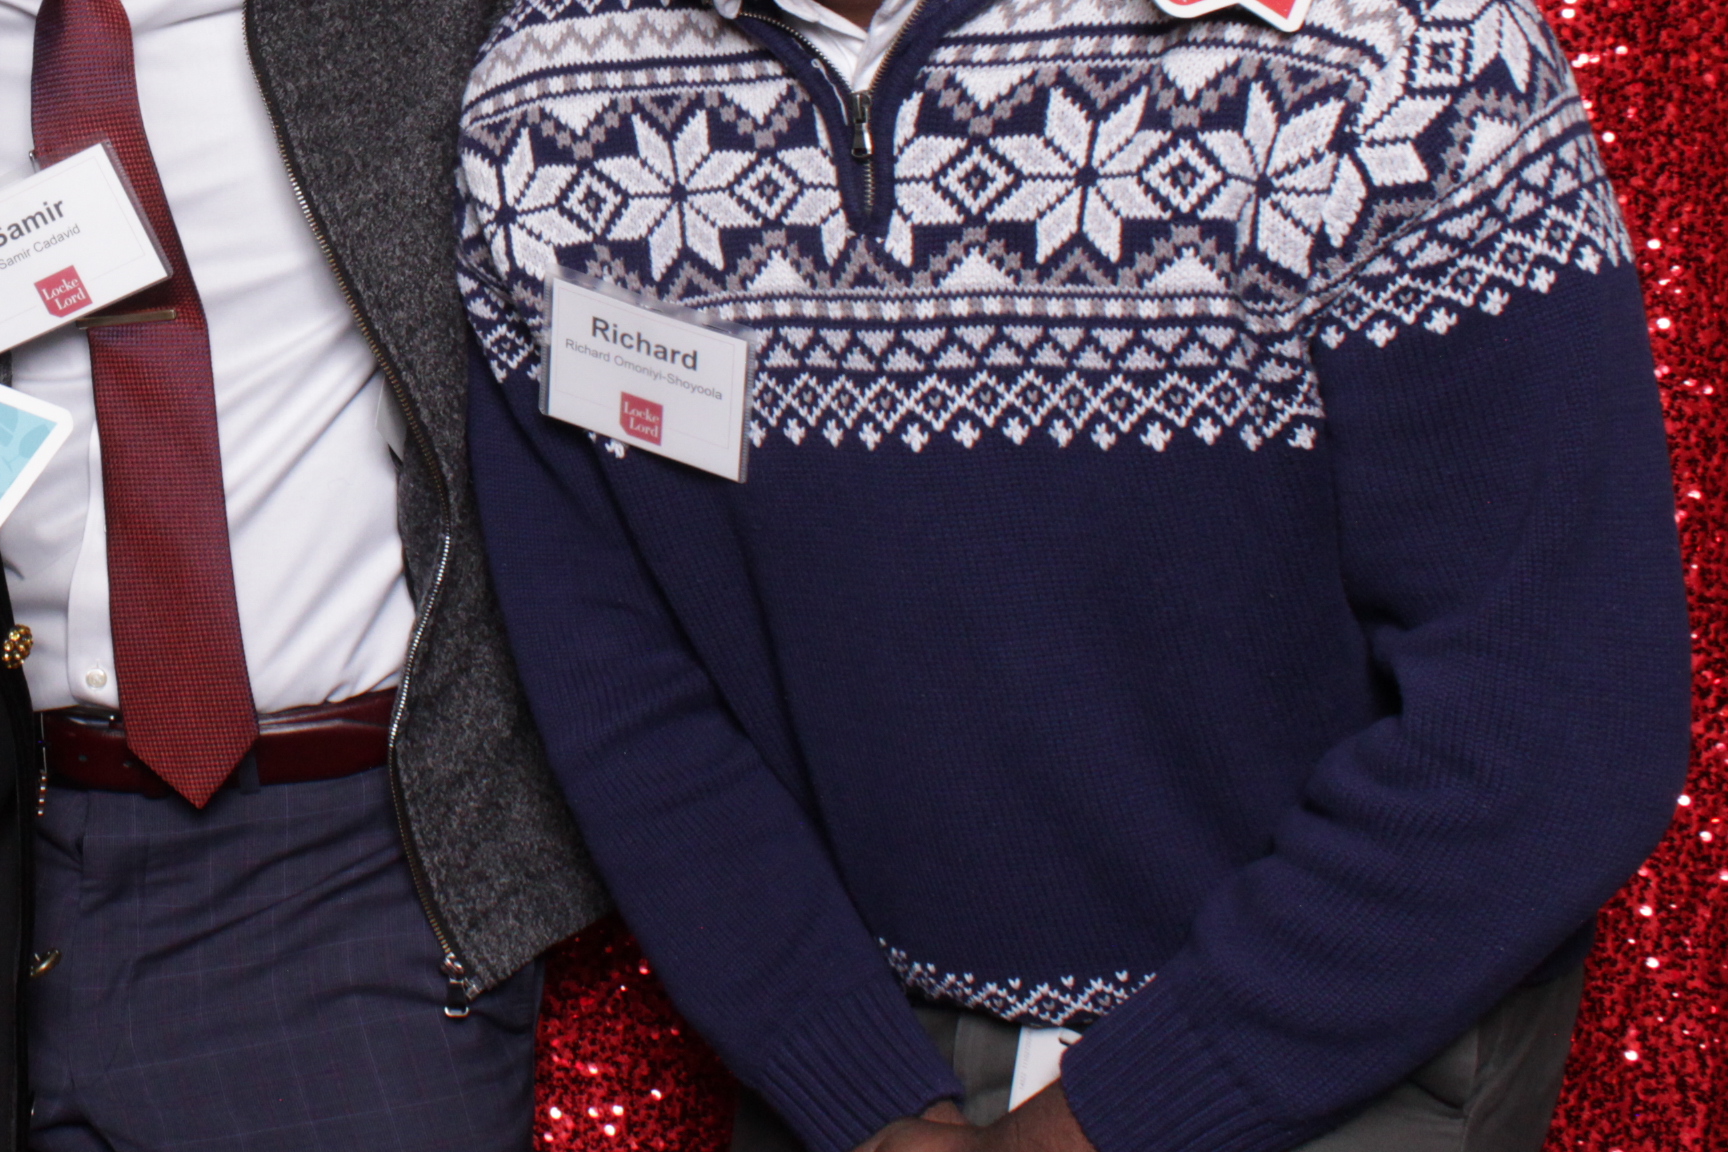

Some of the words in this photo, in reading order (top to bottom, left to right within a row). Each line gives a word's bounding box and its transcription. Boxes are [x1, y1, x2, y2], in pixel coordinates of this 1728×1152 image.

[33, 224, 81, 253] Cadavid
[42, 277, 80, 301] Locke
[55, 288, 86, 311] Lord
[591, 316, 698, 371] Richard
[565, 338, 611, 362] Richard
[614, 355, 723, 400] Omoniyi-Shoyoola
[624, 402, 660, 423] Locke
[629, 417, 659, 438] Lord
